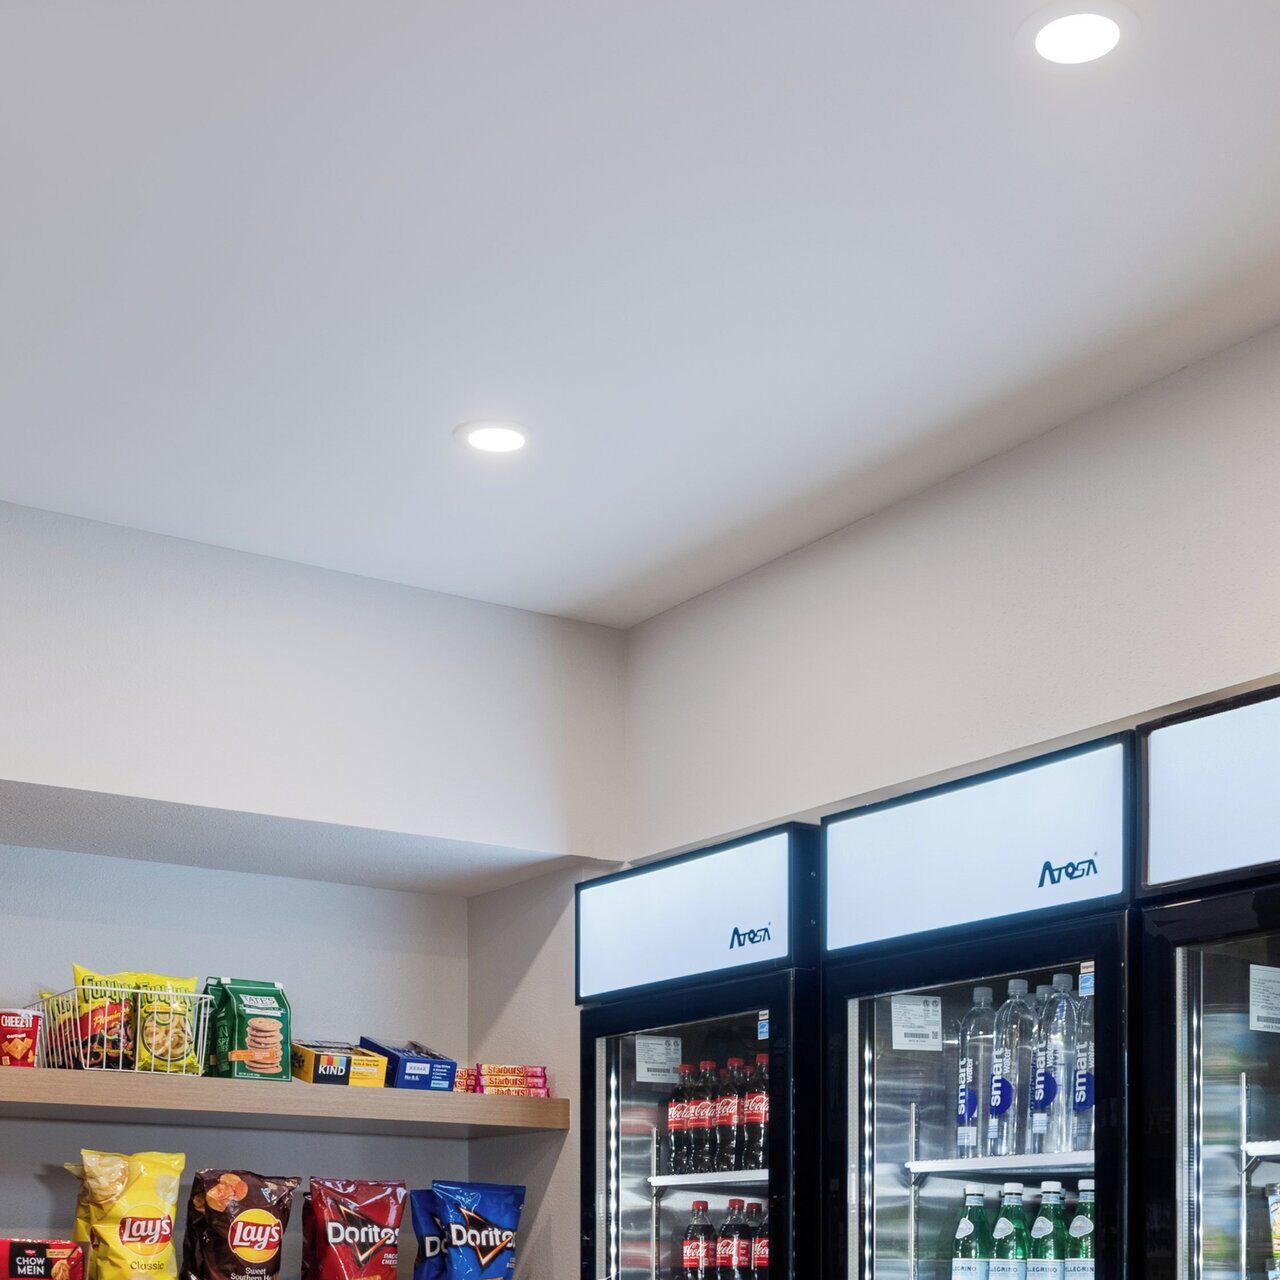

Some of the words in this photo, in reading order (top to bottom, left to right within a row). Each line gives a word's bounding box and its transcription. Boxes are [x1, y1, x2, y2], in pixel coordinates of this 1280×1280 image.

[319, 1065, 345, 1076] KIND
[1003, 1048, 1012, 1074] water
[1035, 1040, 1047, 1102] smart
[1075, 1041, 1088, 1103] smart
[958, 1057, 966, 1116] smart
[991, 1047, 1004, 1107] smart
[122, 1216, 171, 1245] Lay's
[233, 1220, 281, 1251] Lay's
[450, 1223, 516, 1247] Dorito
[16, 1256, 45, 1266] CHOW
[17, 1265, 45, 1275] MEIN
[130, 1261, 164, 1271] Classic
[245, 1267, 266, 1275] Sweet
